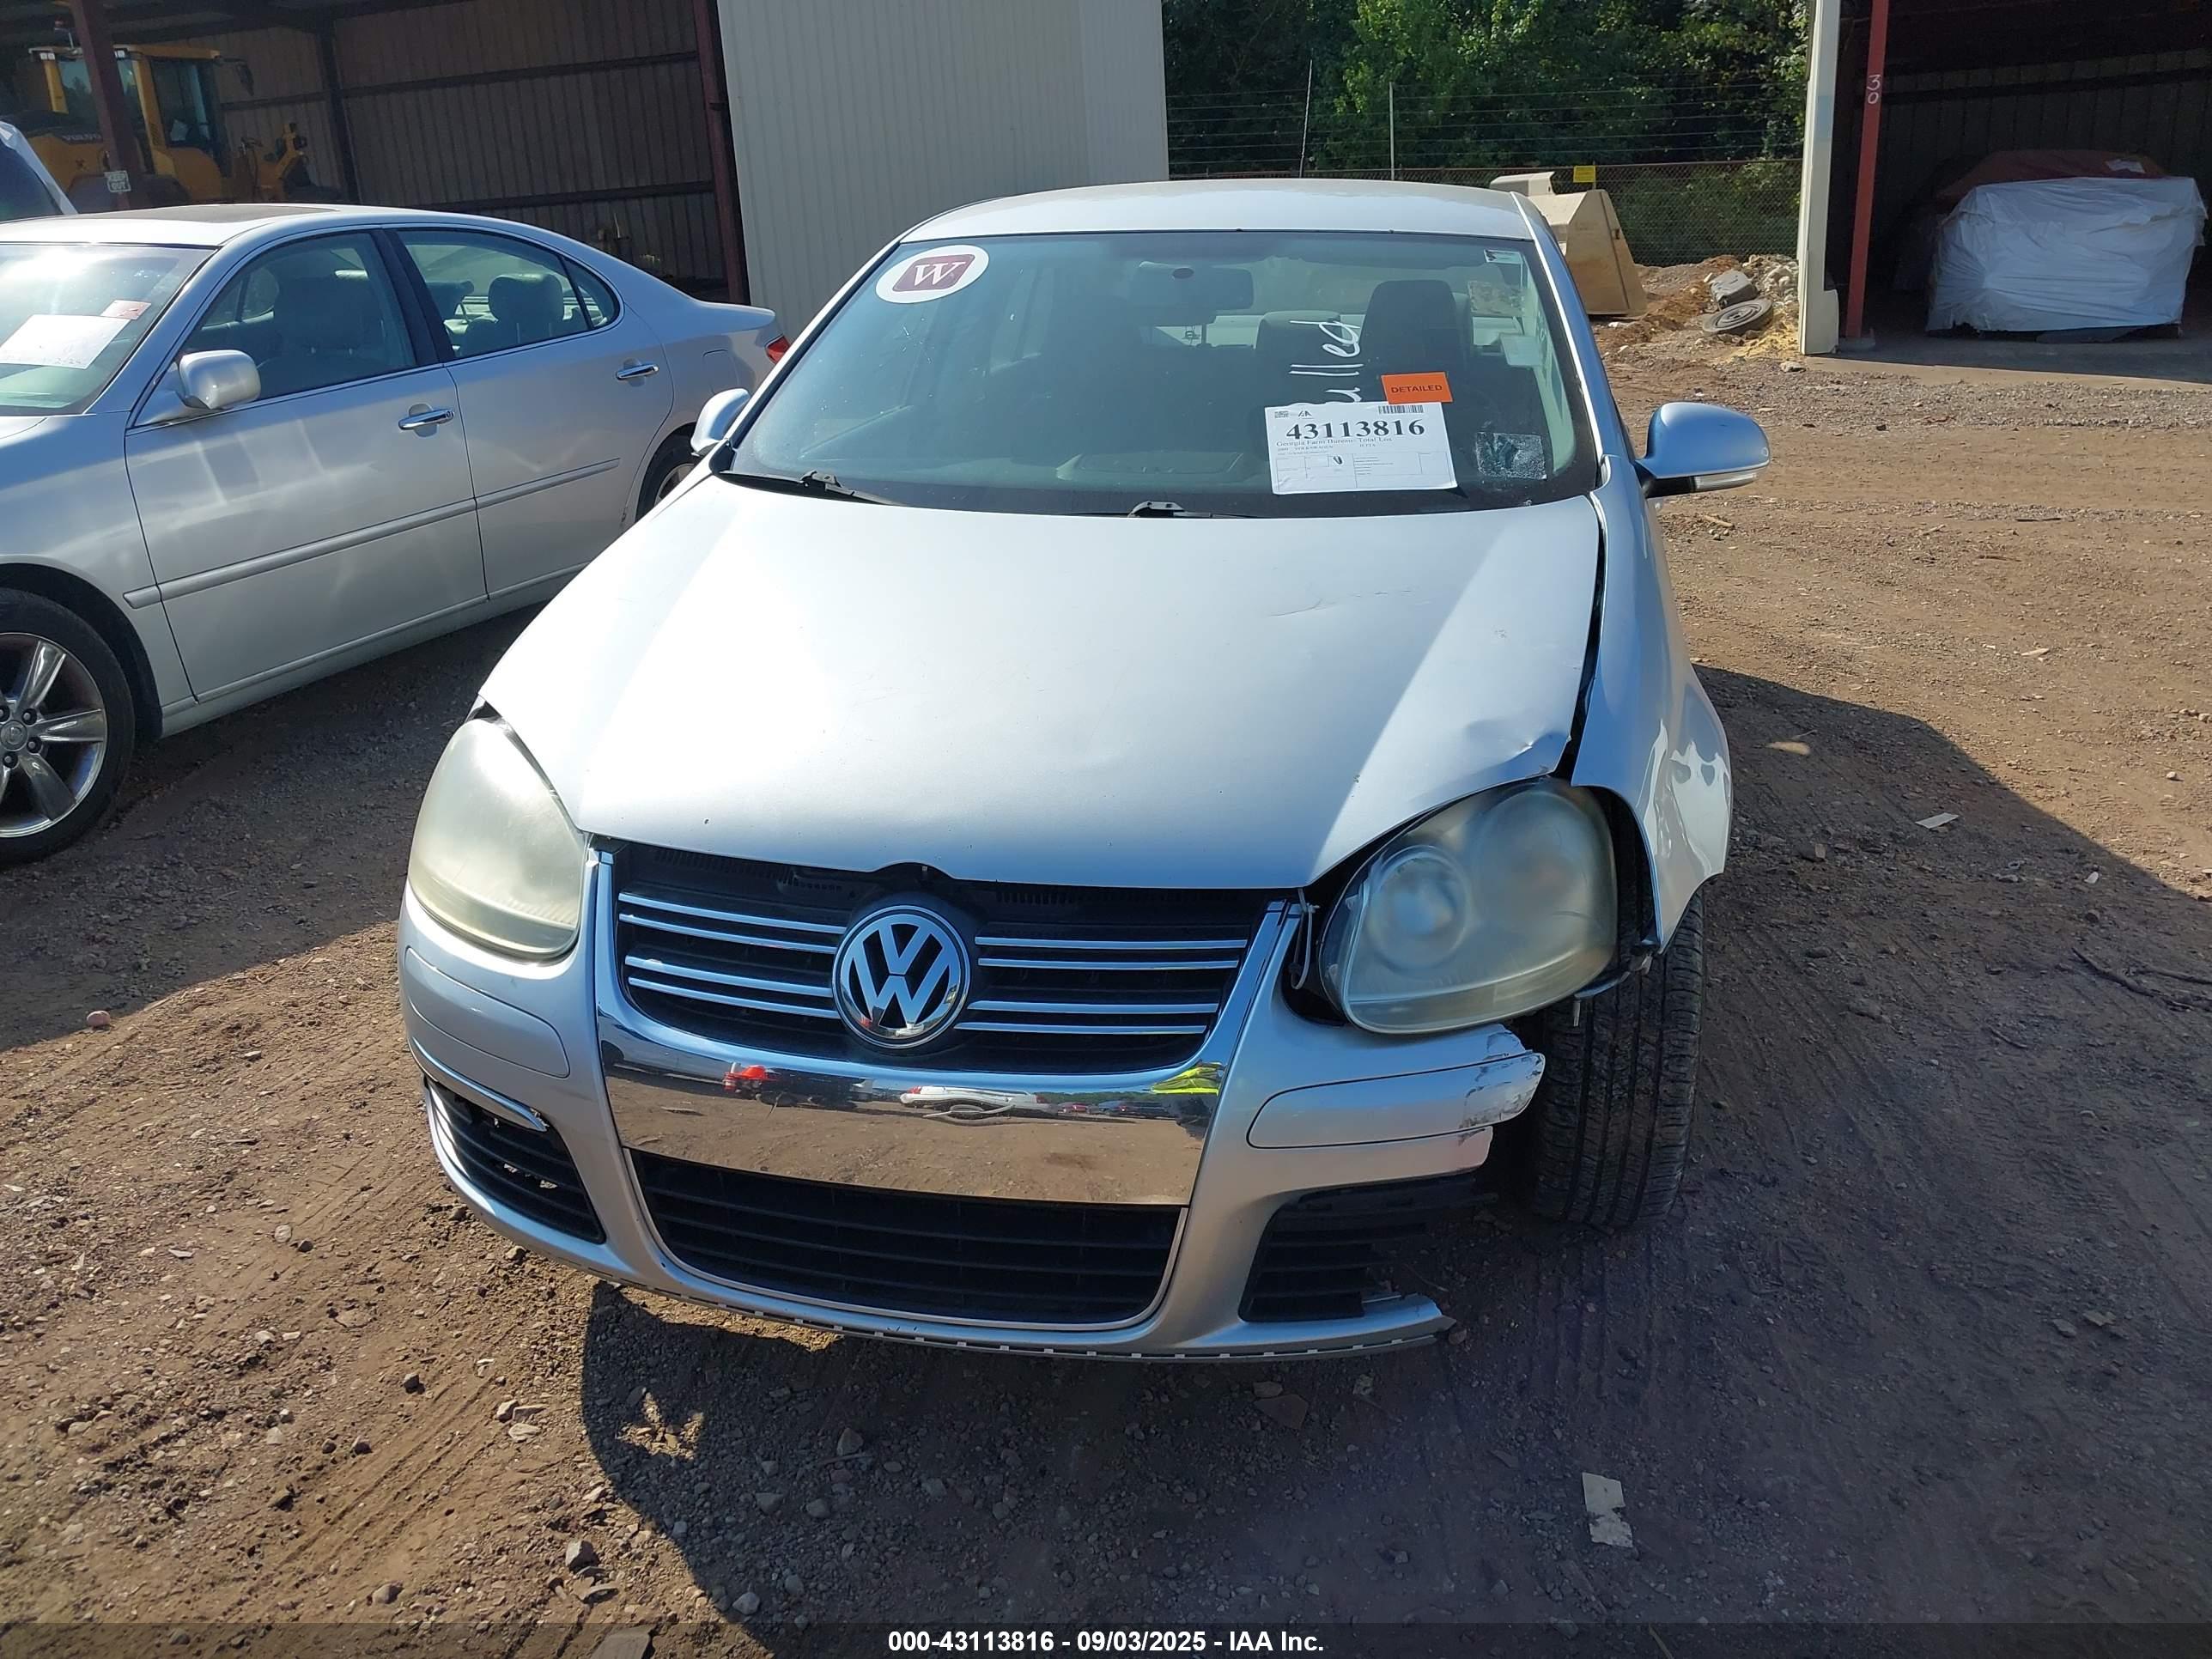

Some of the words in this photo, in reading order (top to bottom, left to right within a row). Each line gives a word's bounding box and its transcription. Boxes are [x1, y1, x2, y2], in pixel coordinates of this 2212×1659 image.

[1867, 74, 1881, 104] 30
[914, 261, 966, 286] W
[1288, 320, 1364, 402] ulled
[1285, 418, 1425, 440] 43113816
